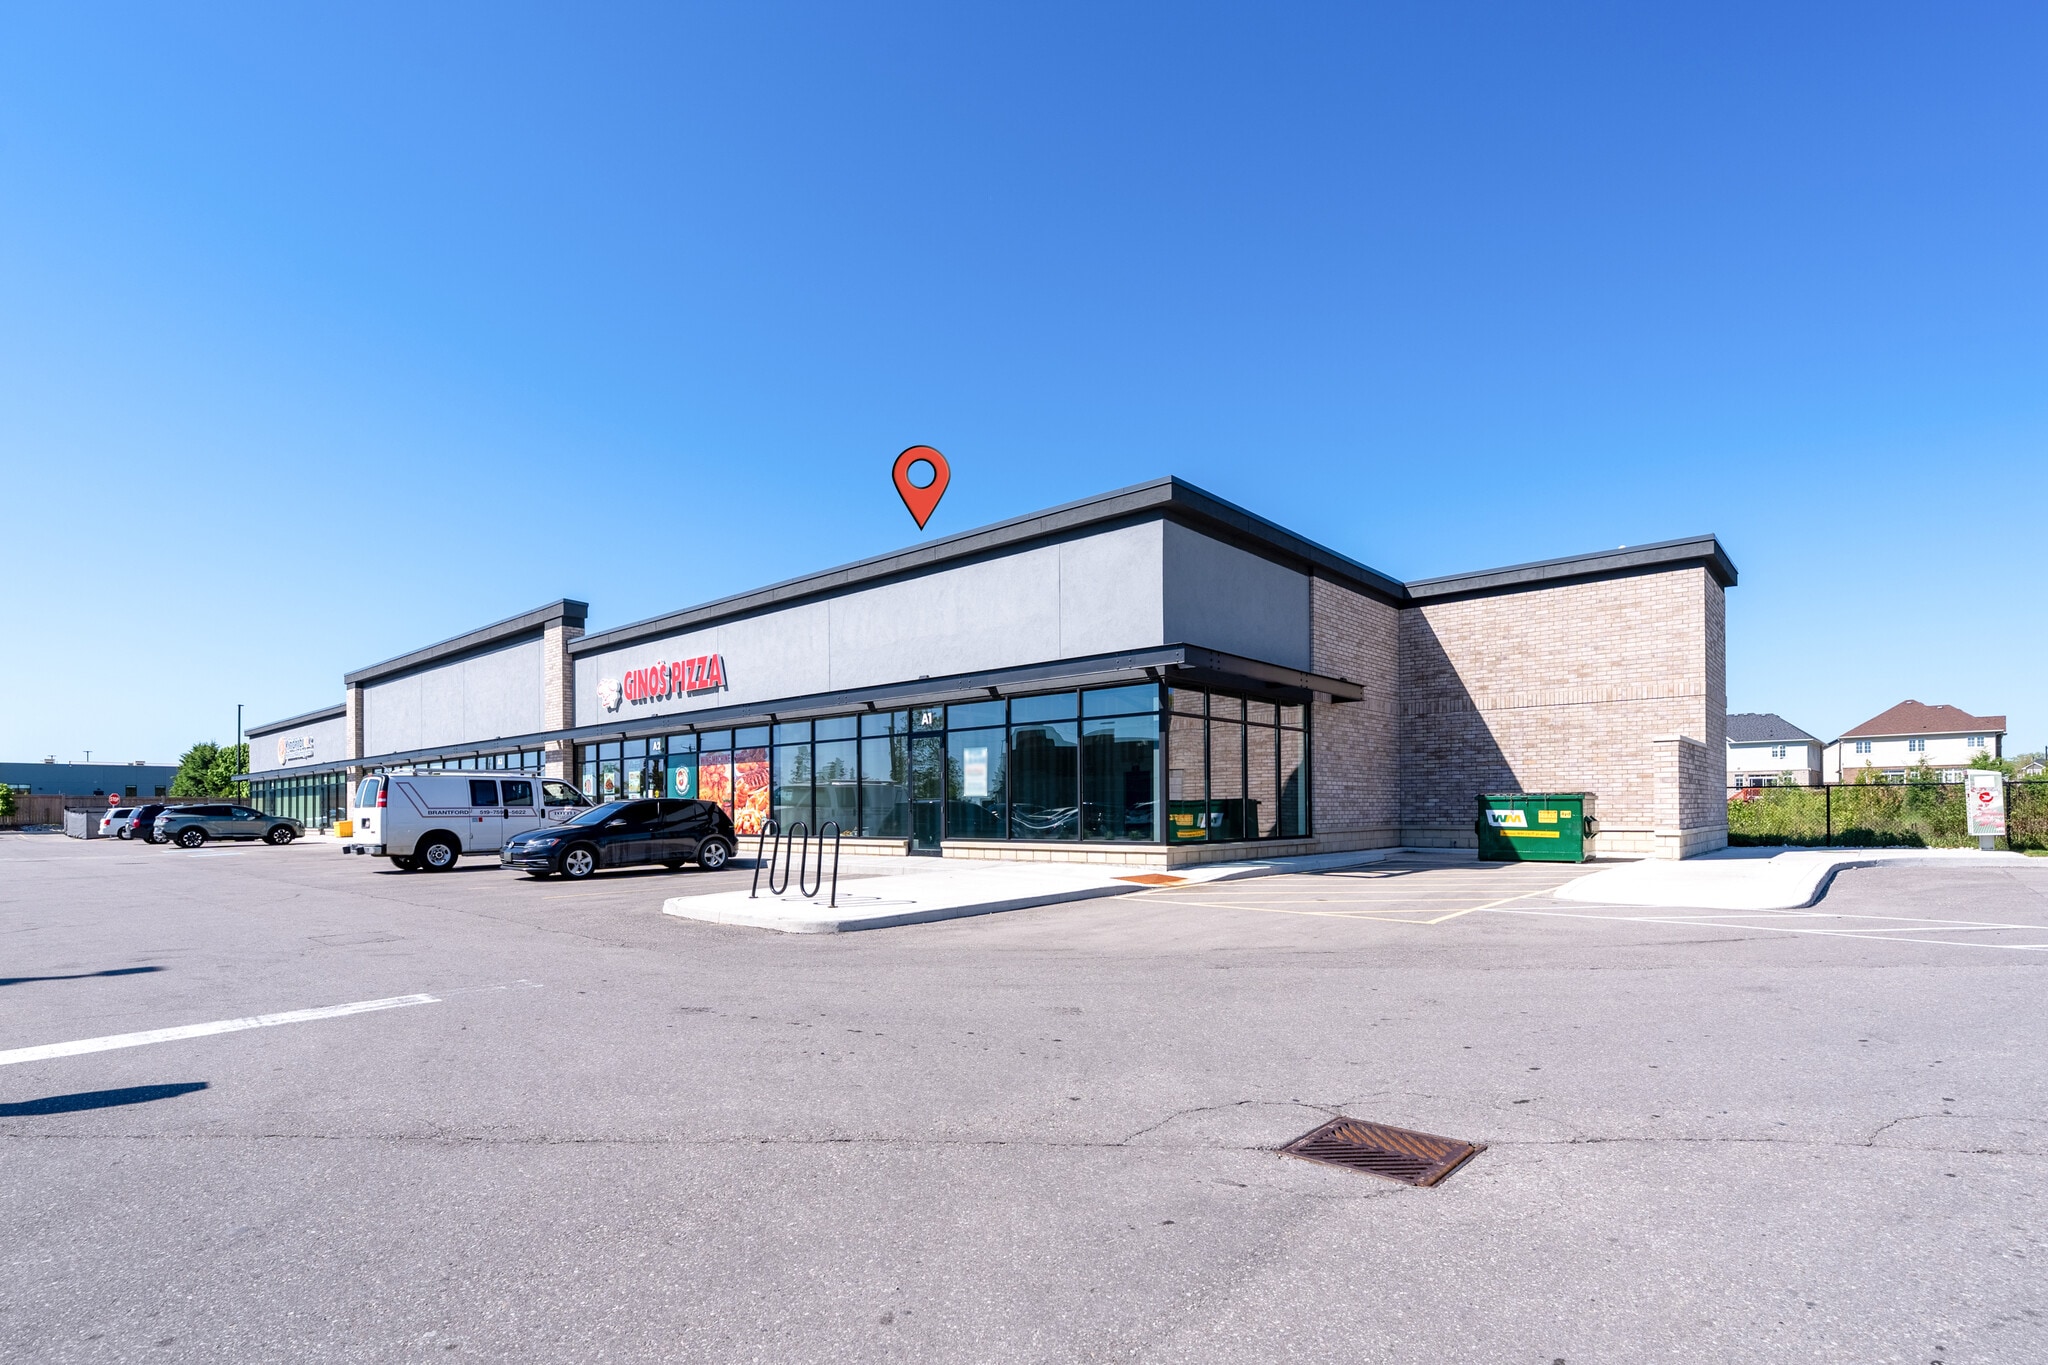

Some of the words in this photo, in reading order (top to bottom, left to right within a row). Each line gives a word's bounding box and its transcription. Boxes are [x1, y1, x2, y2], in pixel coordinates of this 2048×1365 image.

[671, 653, 723, 693] PIZZA
[921, 712, 932, 725] A1
[653, 741, 661, 751] A2
[1491, 814, 1522, 823] WM
